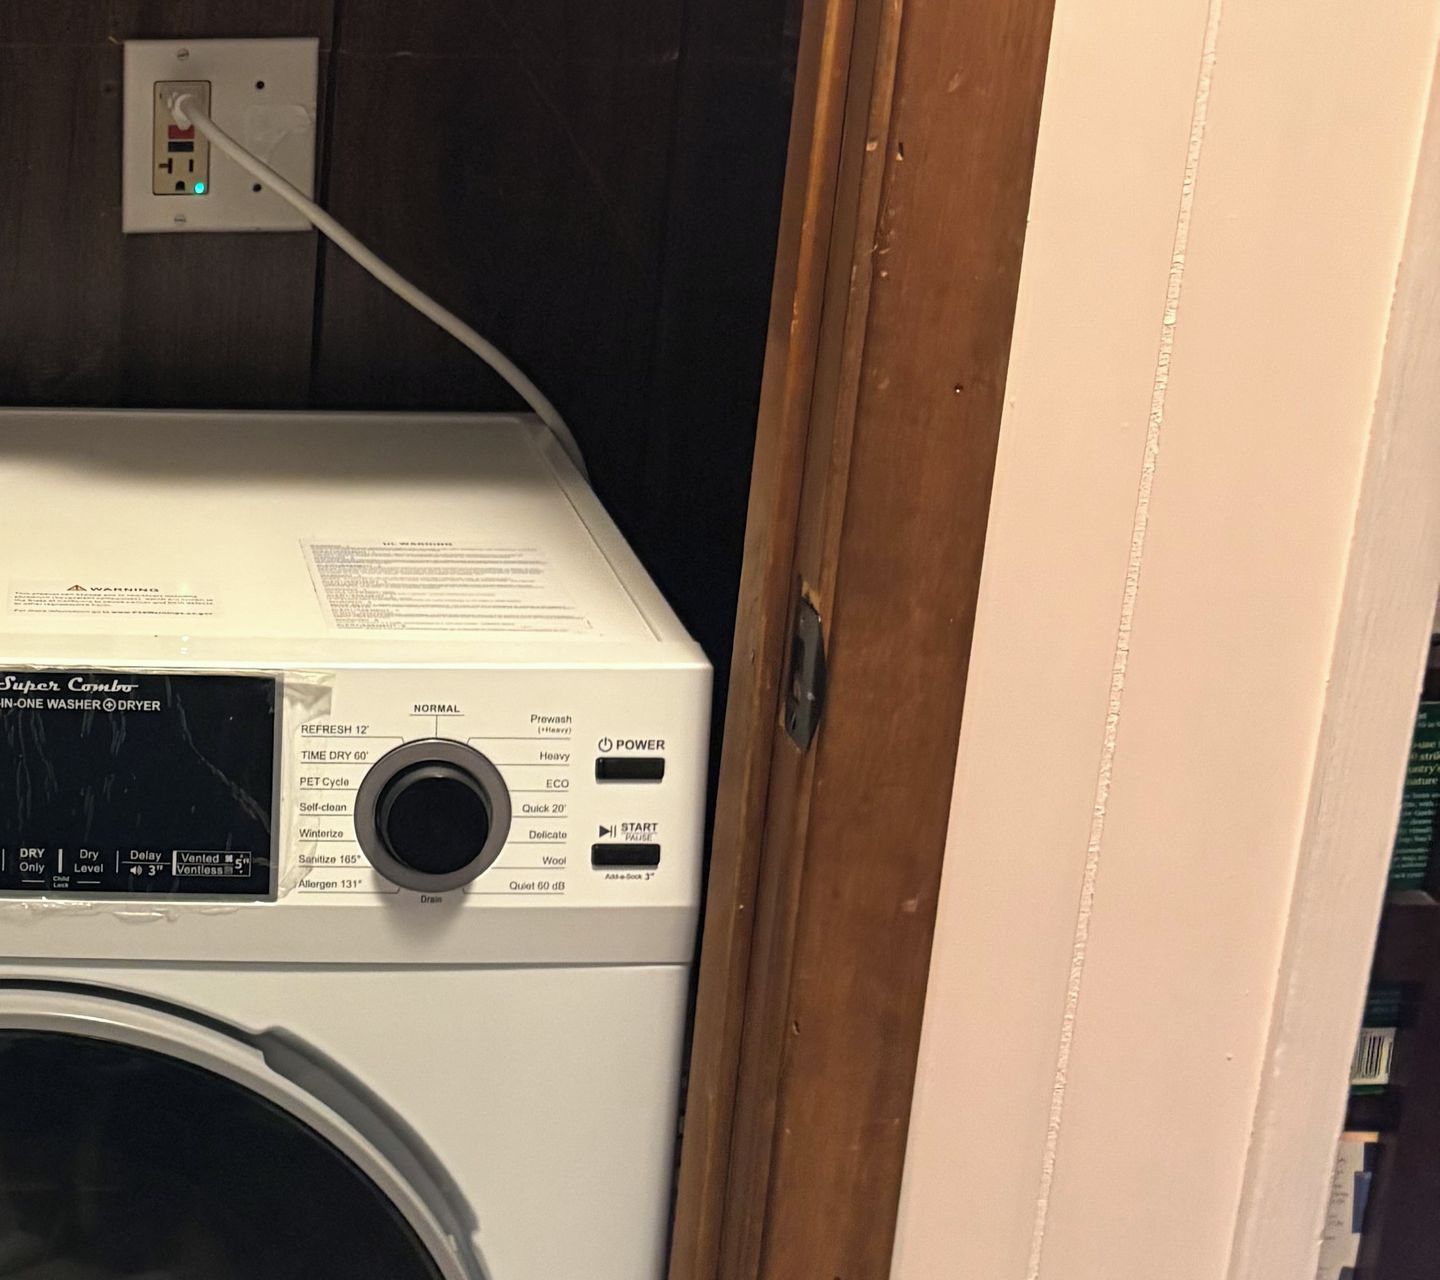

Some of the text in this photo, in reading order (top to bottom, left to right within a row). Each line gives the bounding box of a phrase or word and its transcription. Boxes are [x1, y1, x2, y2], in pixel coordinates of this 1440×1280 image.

[67, 677, 139, 694] Combo
[47, 698, 102, 710] WASHER
[117, 700, 161, 711] DRYER
[413, 704, 461, 713] NORMAL
[530, 714, 572, 724] Prewash
[301, 725, 352, 734] REFRESH
[616, 739, 666, 751] POWER
[301, 751, 326, 760] TIME
[329, 751, 352, 760] DRY
[539, 751, 570, 762] Heavy
[299, 777, 350, 789] PET Cycle
[546, 779, 570, 789] ECO
[299, 802, 347, 812] Self-clean
[522, 804, 550, 814] Quick
[621, 822, 659, 832] START
[299, 828, 344, 838] Winterize
[529, 830, 567, 839] Delicate
[625, 833, 653, 841] PAUSE
[19, 848, 46, 858] DRY
[79, 849, 99, 861] Dry
[130, 850, 162, 862] Delay
[181, 853, 220, 863] Vented
[298, 854, 337, 864] Sanitize
[542, 856, 567, 865] Wool
[19, 861, 45, 874] Only
[74, 863, 104, 873] Level
[177, 865, 223, 875] Ventless
[298, 879, 338, 890] Allergen
[509, 881, 565, 891] Quiet 60 dB
[420, 895, 442, 903] Drain
